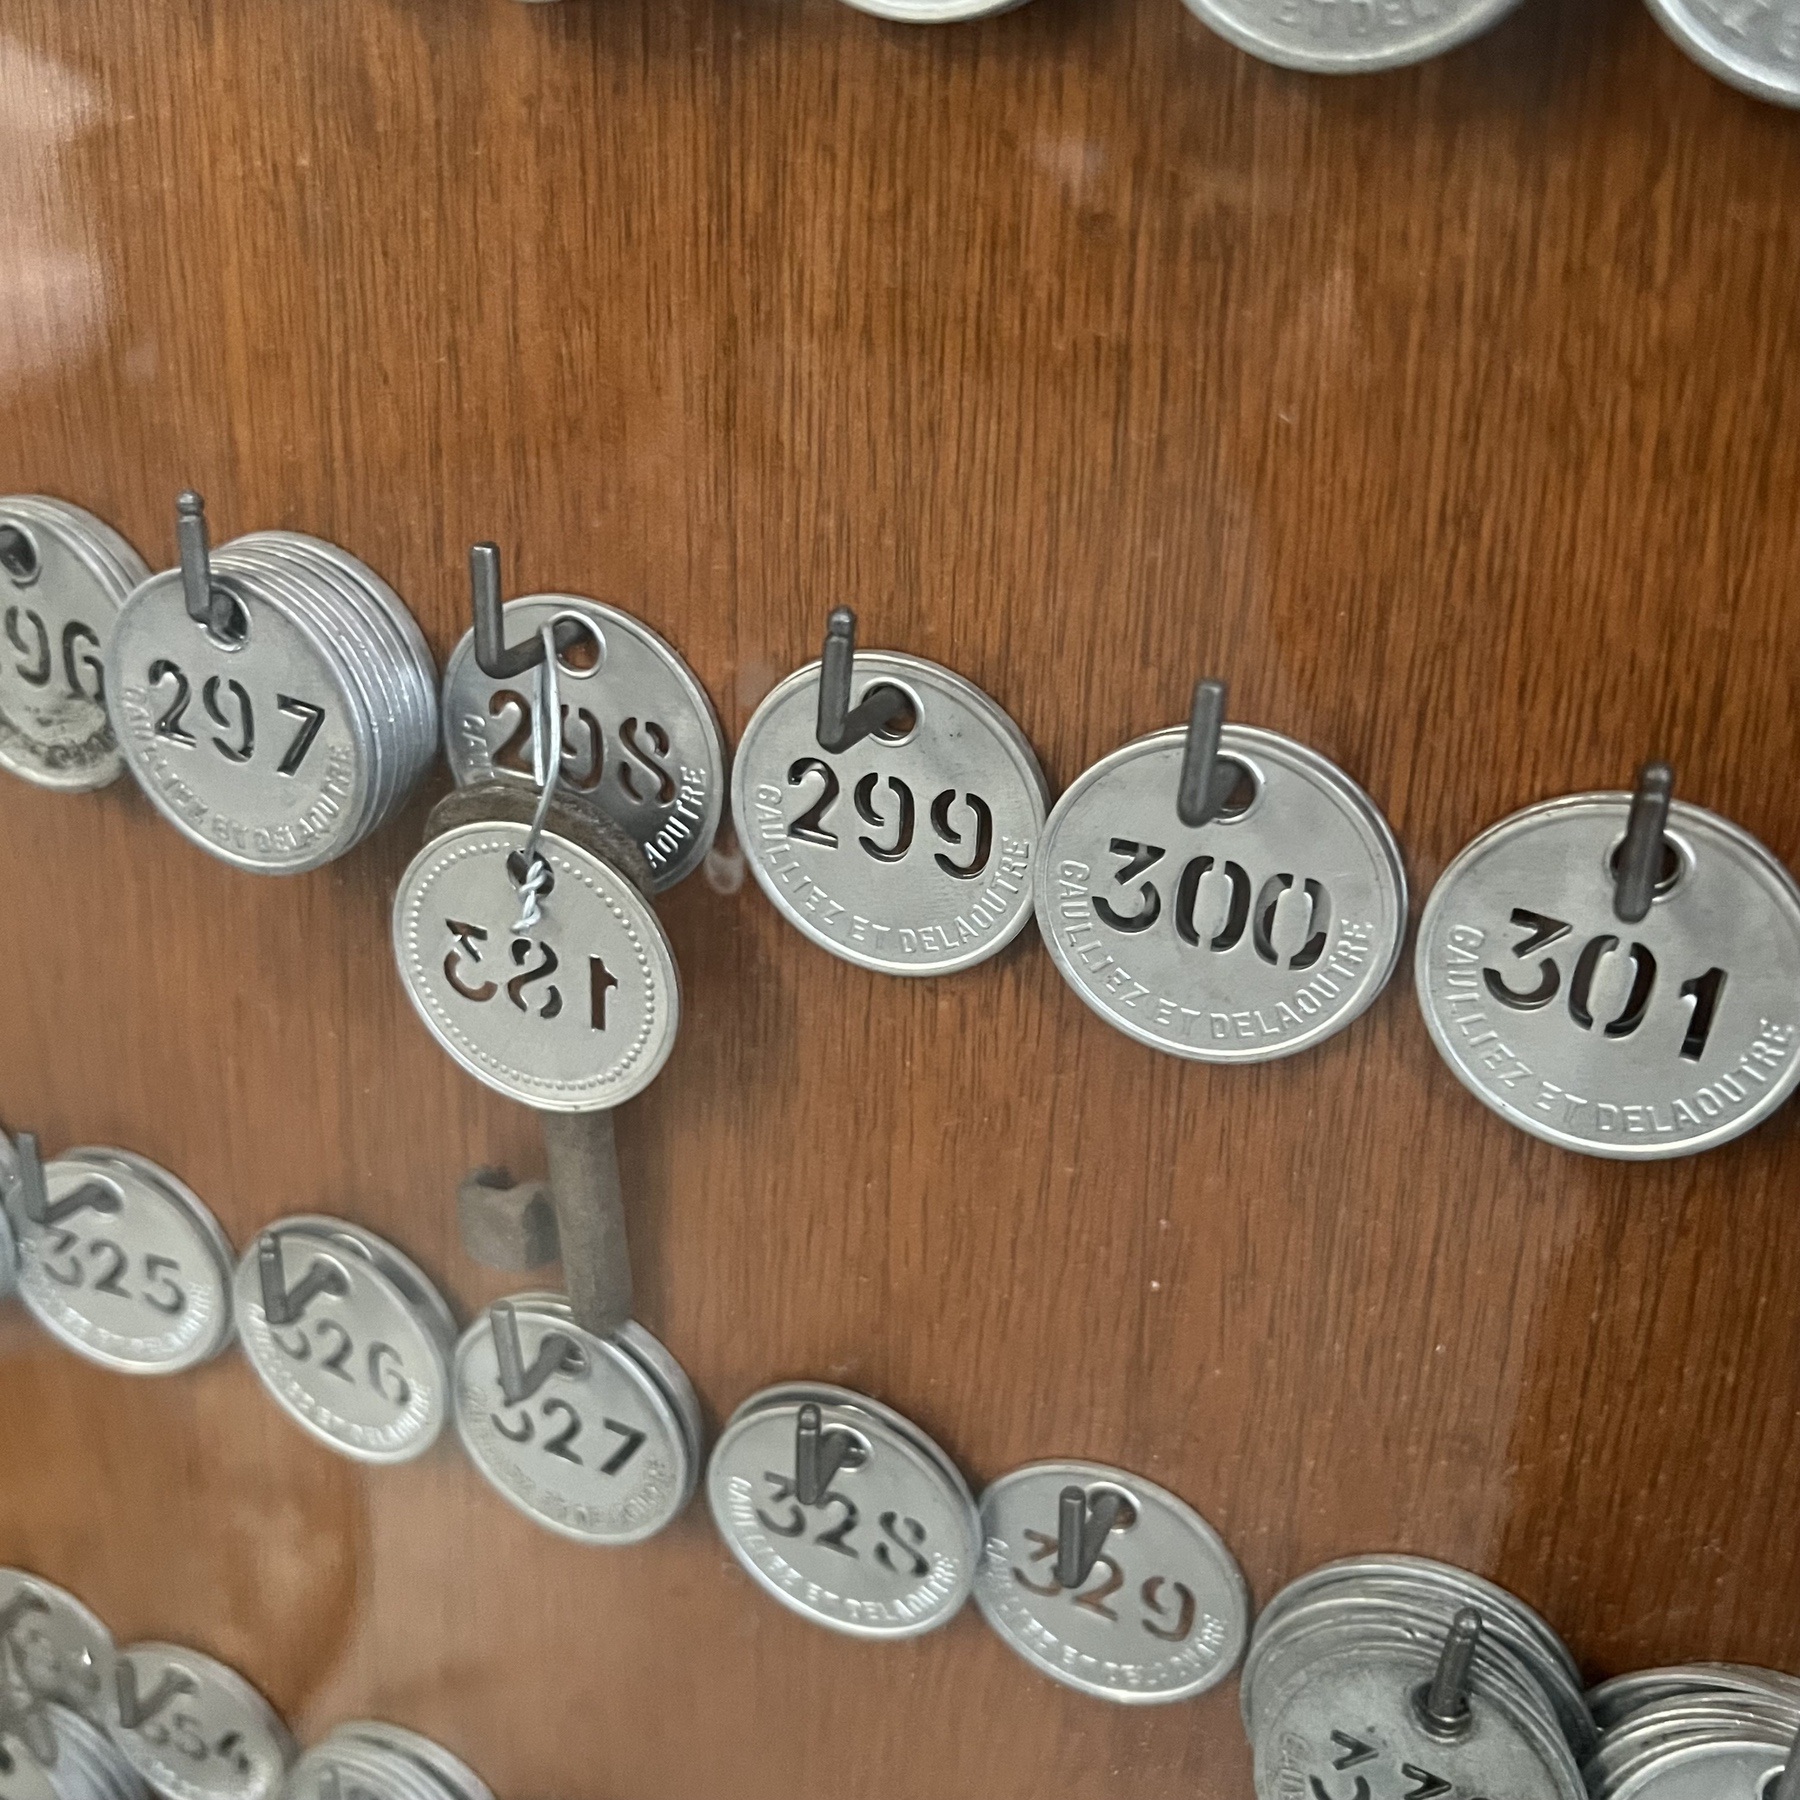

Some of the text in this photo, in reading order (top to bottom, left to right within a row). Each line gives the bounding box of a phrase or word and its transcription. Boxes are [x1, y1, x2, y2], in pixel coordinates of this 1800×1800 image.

[4, 604, 105, 702] 96
[148, 660, 326, 777] 297
[488, 689, 677, 810] 298
[643, 765, 707, 869] AOUTRE
[787, 756, 994, 880] 299
[850, 914, 892, 950] ET
[898, 834, 1032, 954] DELAOUTRE
[1092, 836, 1333, 971] 300
[1154, 997, 1202, 1036] ET
[1208, 917, 1376, 1040] DELAOUTRE
[1481, 907, 1730, 1063] 301
[1532, 1080, 1589, 1124] ET
[1596, 1016, 1796, 1133] DELAOUTRE
[41, 1225, 188, 1316] 325
[756, 1470, 931, 1579] 328
[1012, 1527, 1197, 1644] 329
